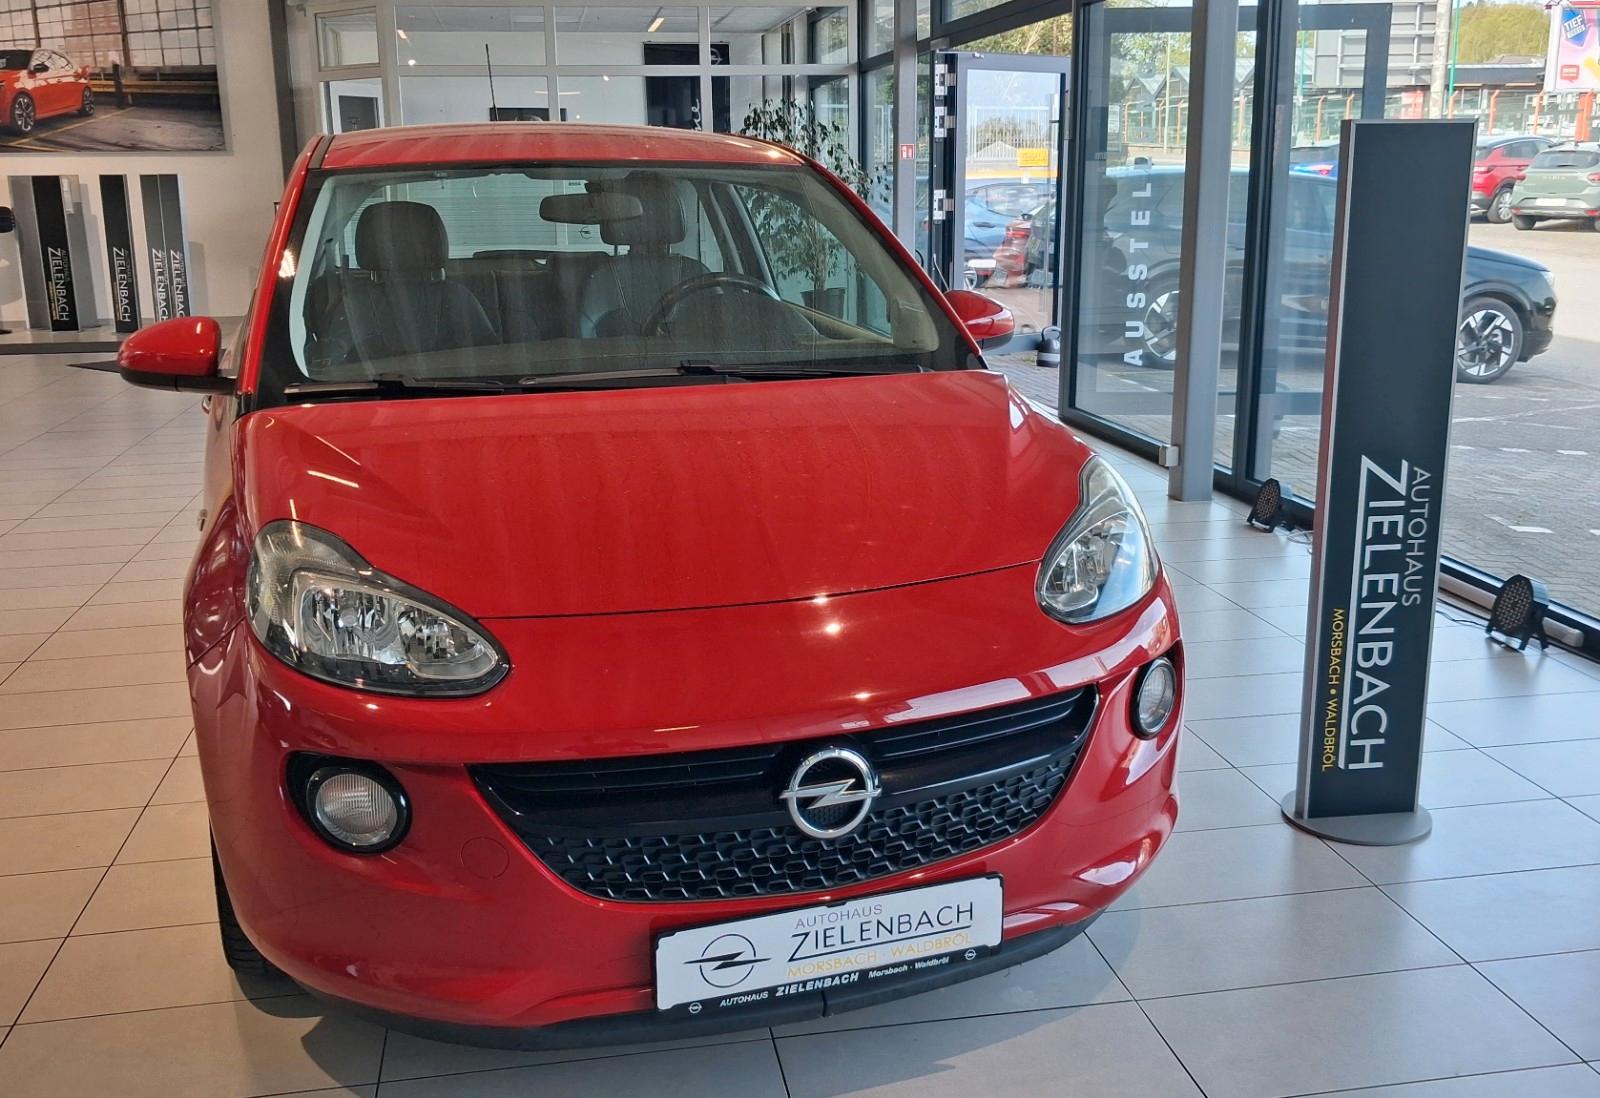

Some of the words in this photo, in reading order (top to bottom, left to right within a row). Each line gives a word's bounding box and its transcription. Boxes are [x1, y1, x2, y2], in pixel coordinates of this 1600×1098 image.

[47, 246, 70, 321] ZIELENBACH
[113, 246, 131, 322] ZIELENBACH
[170, 249, 185, 317] ZIELENBAC
[1402, 465, 1431, 606] AUTOHAUS
[1328, 608, 1344, 685] MORSBACH
[1338, 454, 1408, 770] ZIELENBACH
[1321, 698, 1338, 771] WALDBRÖL
[787, 901, 974, 962] ZIELENBACH
[795, 904, 883, 929] AUTOHAUS
[719, 991, 769, 1008] AUTOHAUS
[775, 972, 859, 997] ZIELENBACH
[868, 964, 909, 979] Morsbach
[914, 956, 950, 970] Waldbröl
[787, 951, 878, 978] MORSBACH
[890, 932, 972, 958] WALDBRÖL
